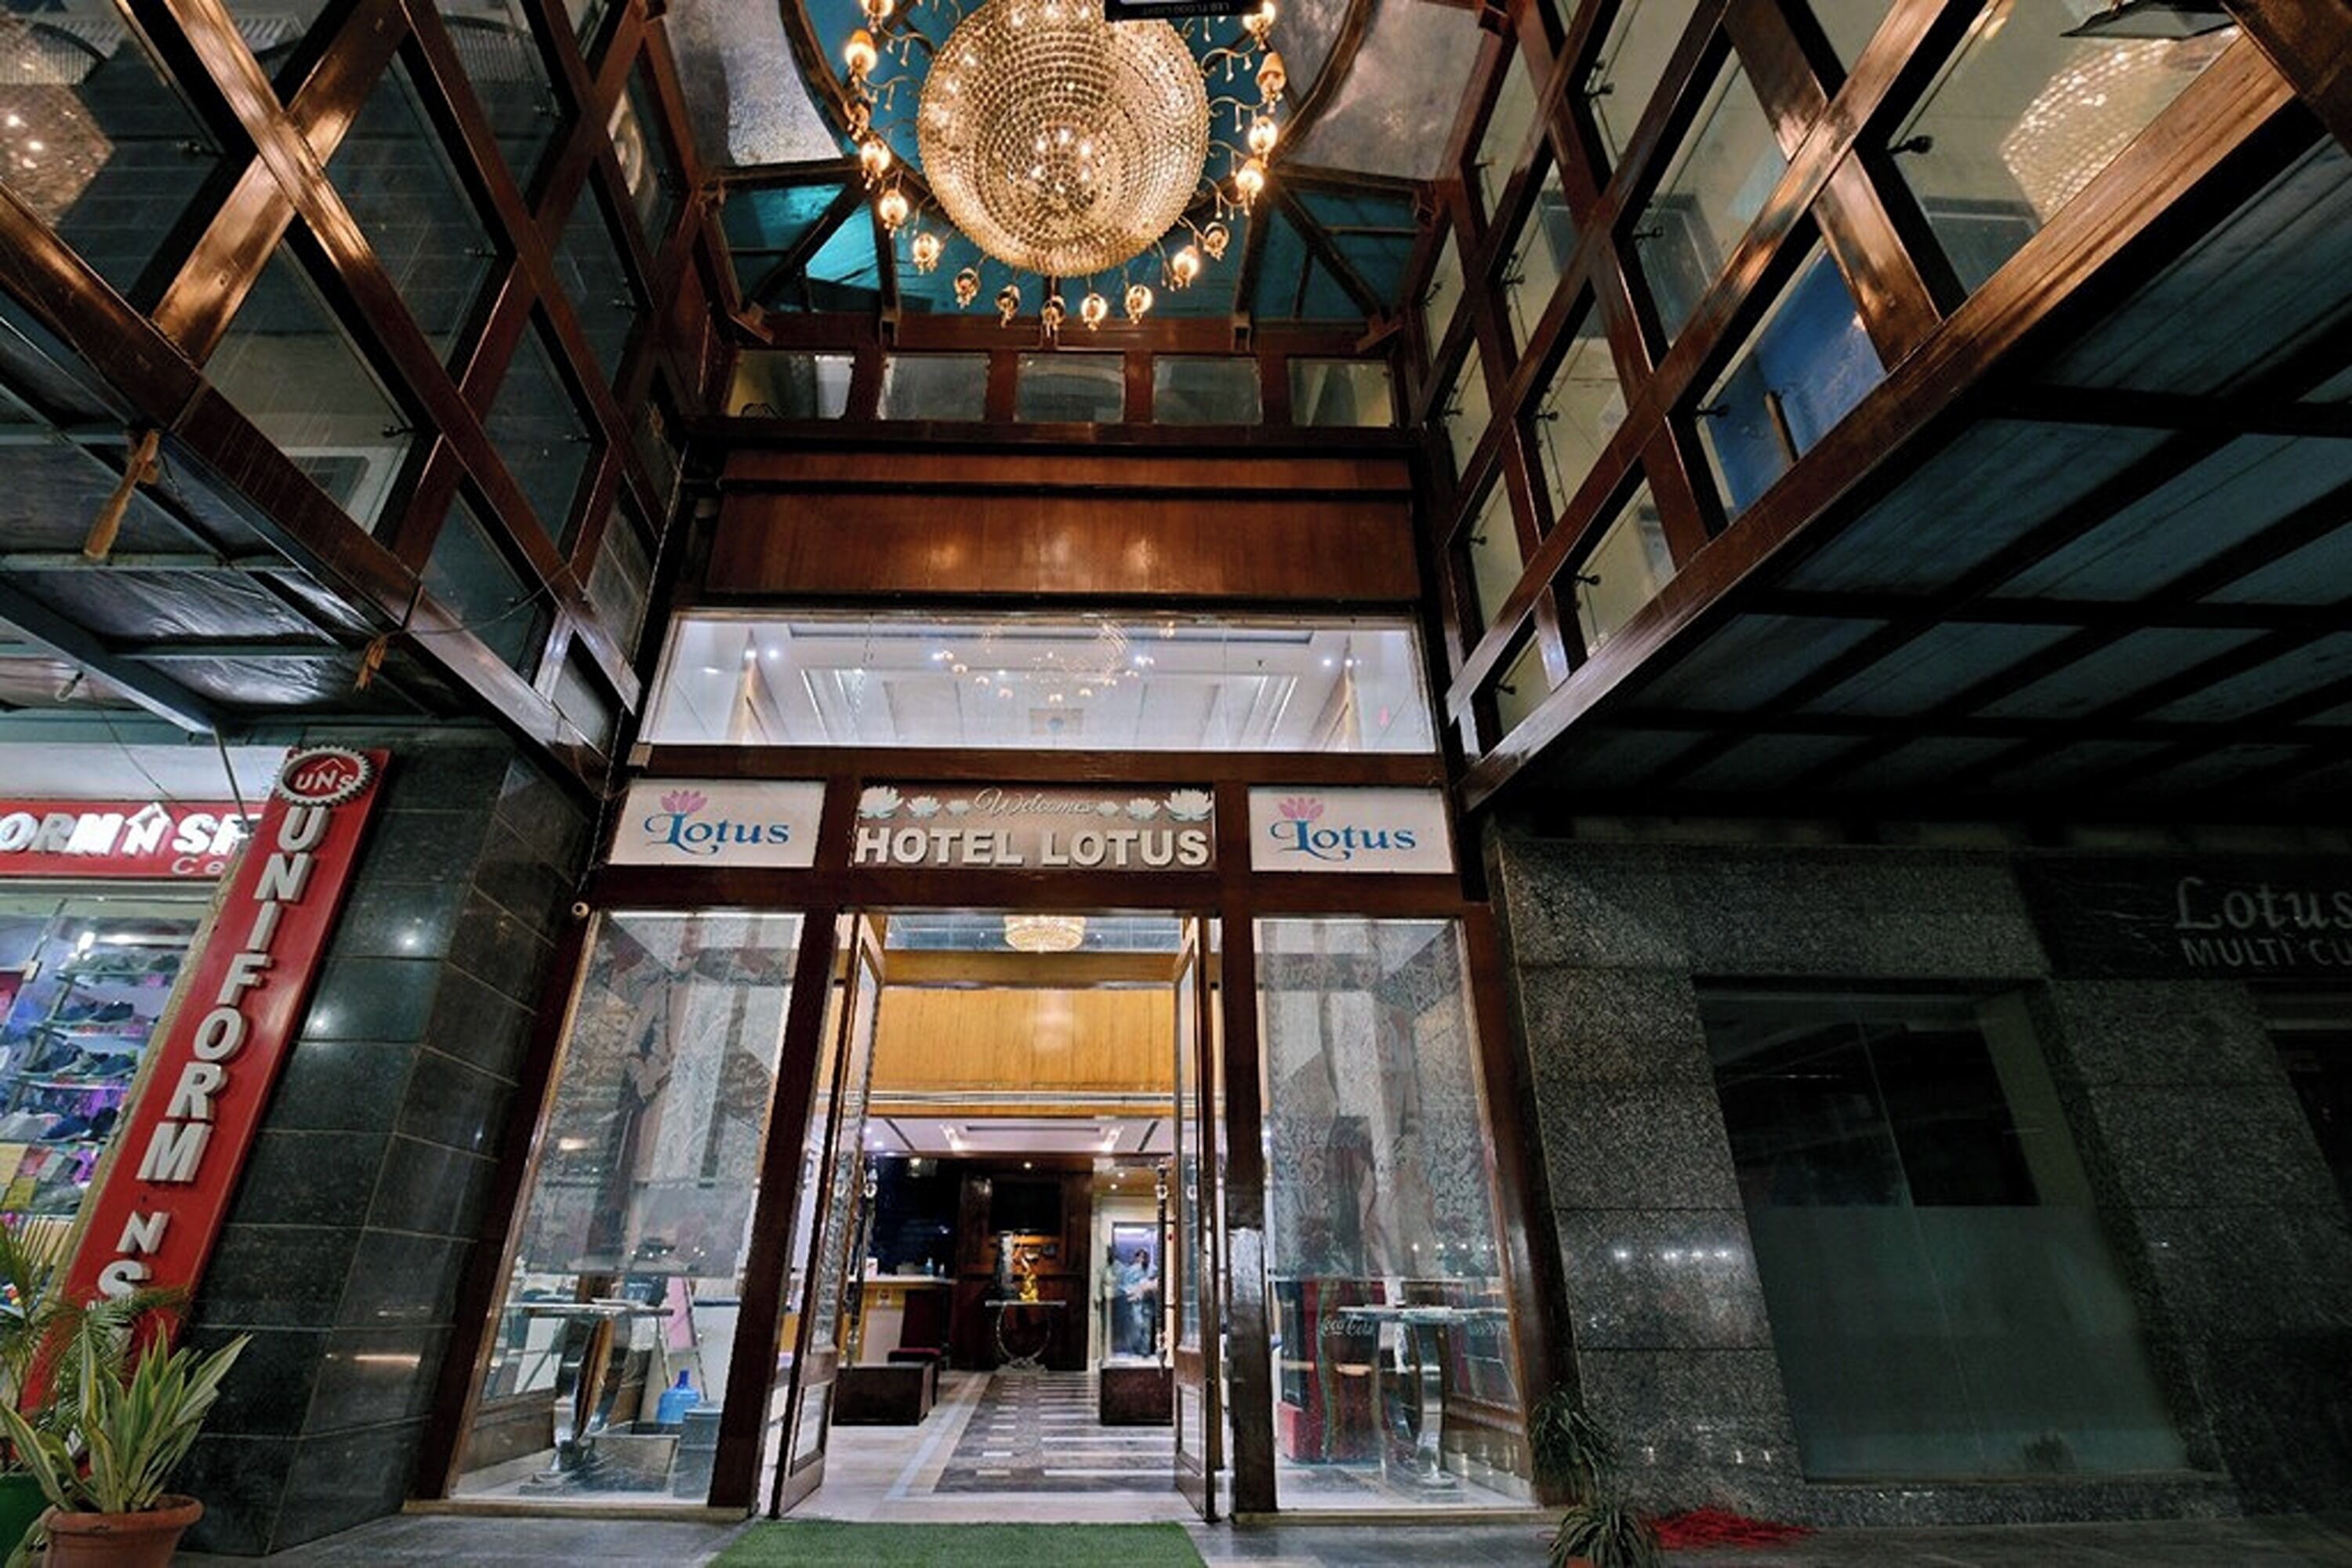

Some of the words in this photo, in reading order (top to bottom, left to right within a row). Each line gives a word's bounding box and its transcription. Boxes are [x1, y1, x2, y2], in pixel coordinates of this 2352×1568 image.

[294, 770, 354, 791] UNS
[643, 812, 790, 855] Lotus
[854, 826, 1025, 865] HOTEL
[1041, 829, 1210, 867] LOTUS
[1269, 820, 1417, 861] Lotus
[2173, 876, 2352, 930] Lotus
[2180, 938, 2296, 966] MULTI
[136, 806, 330, 1183] UNIFORM
